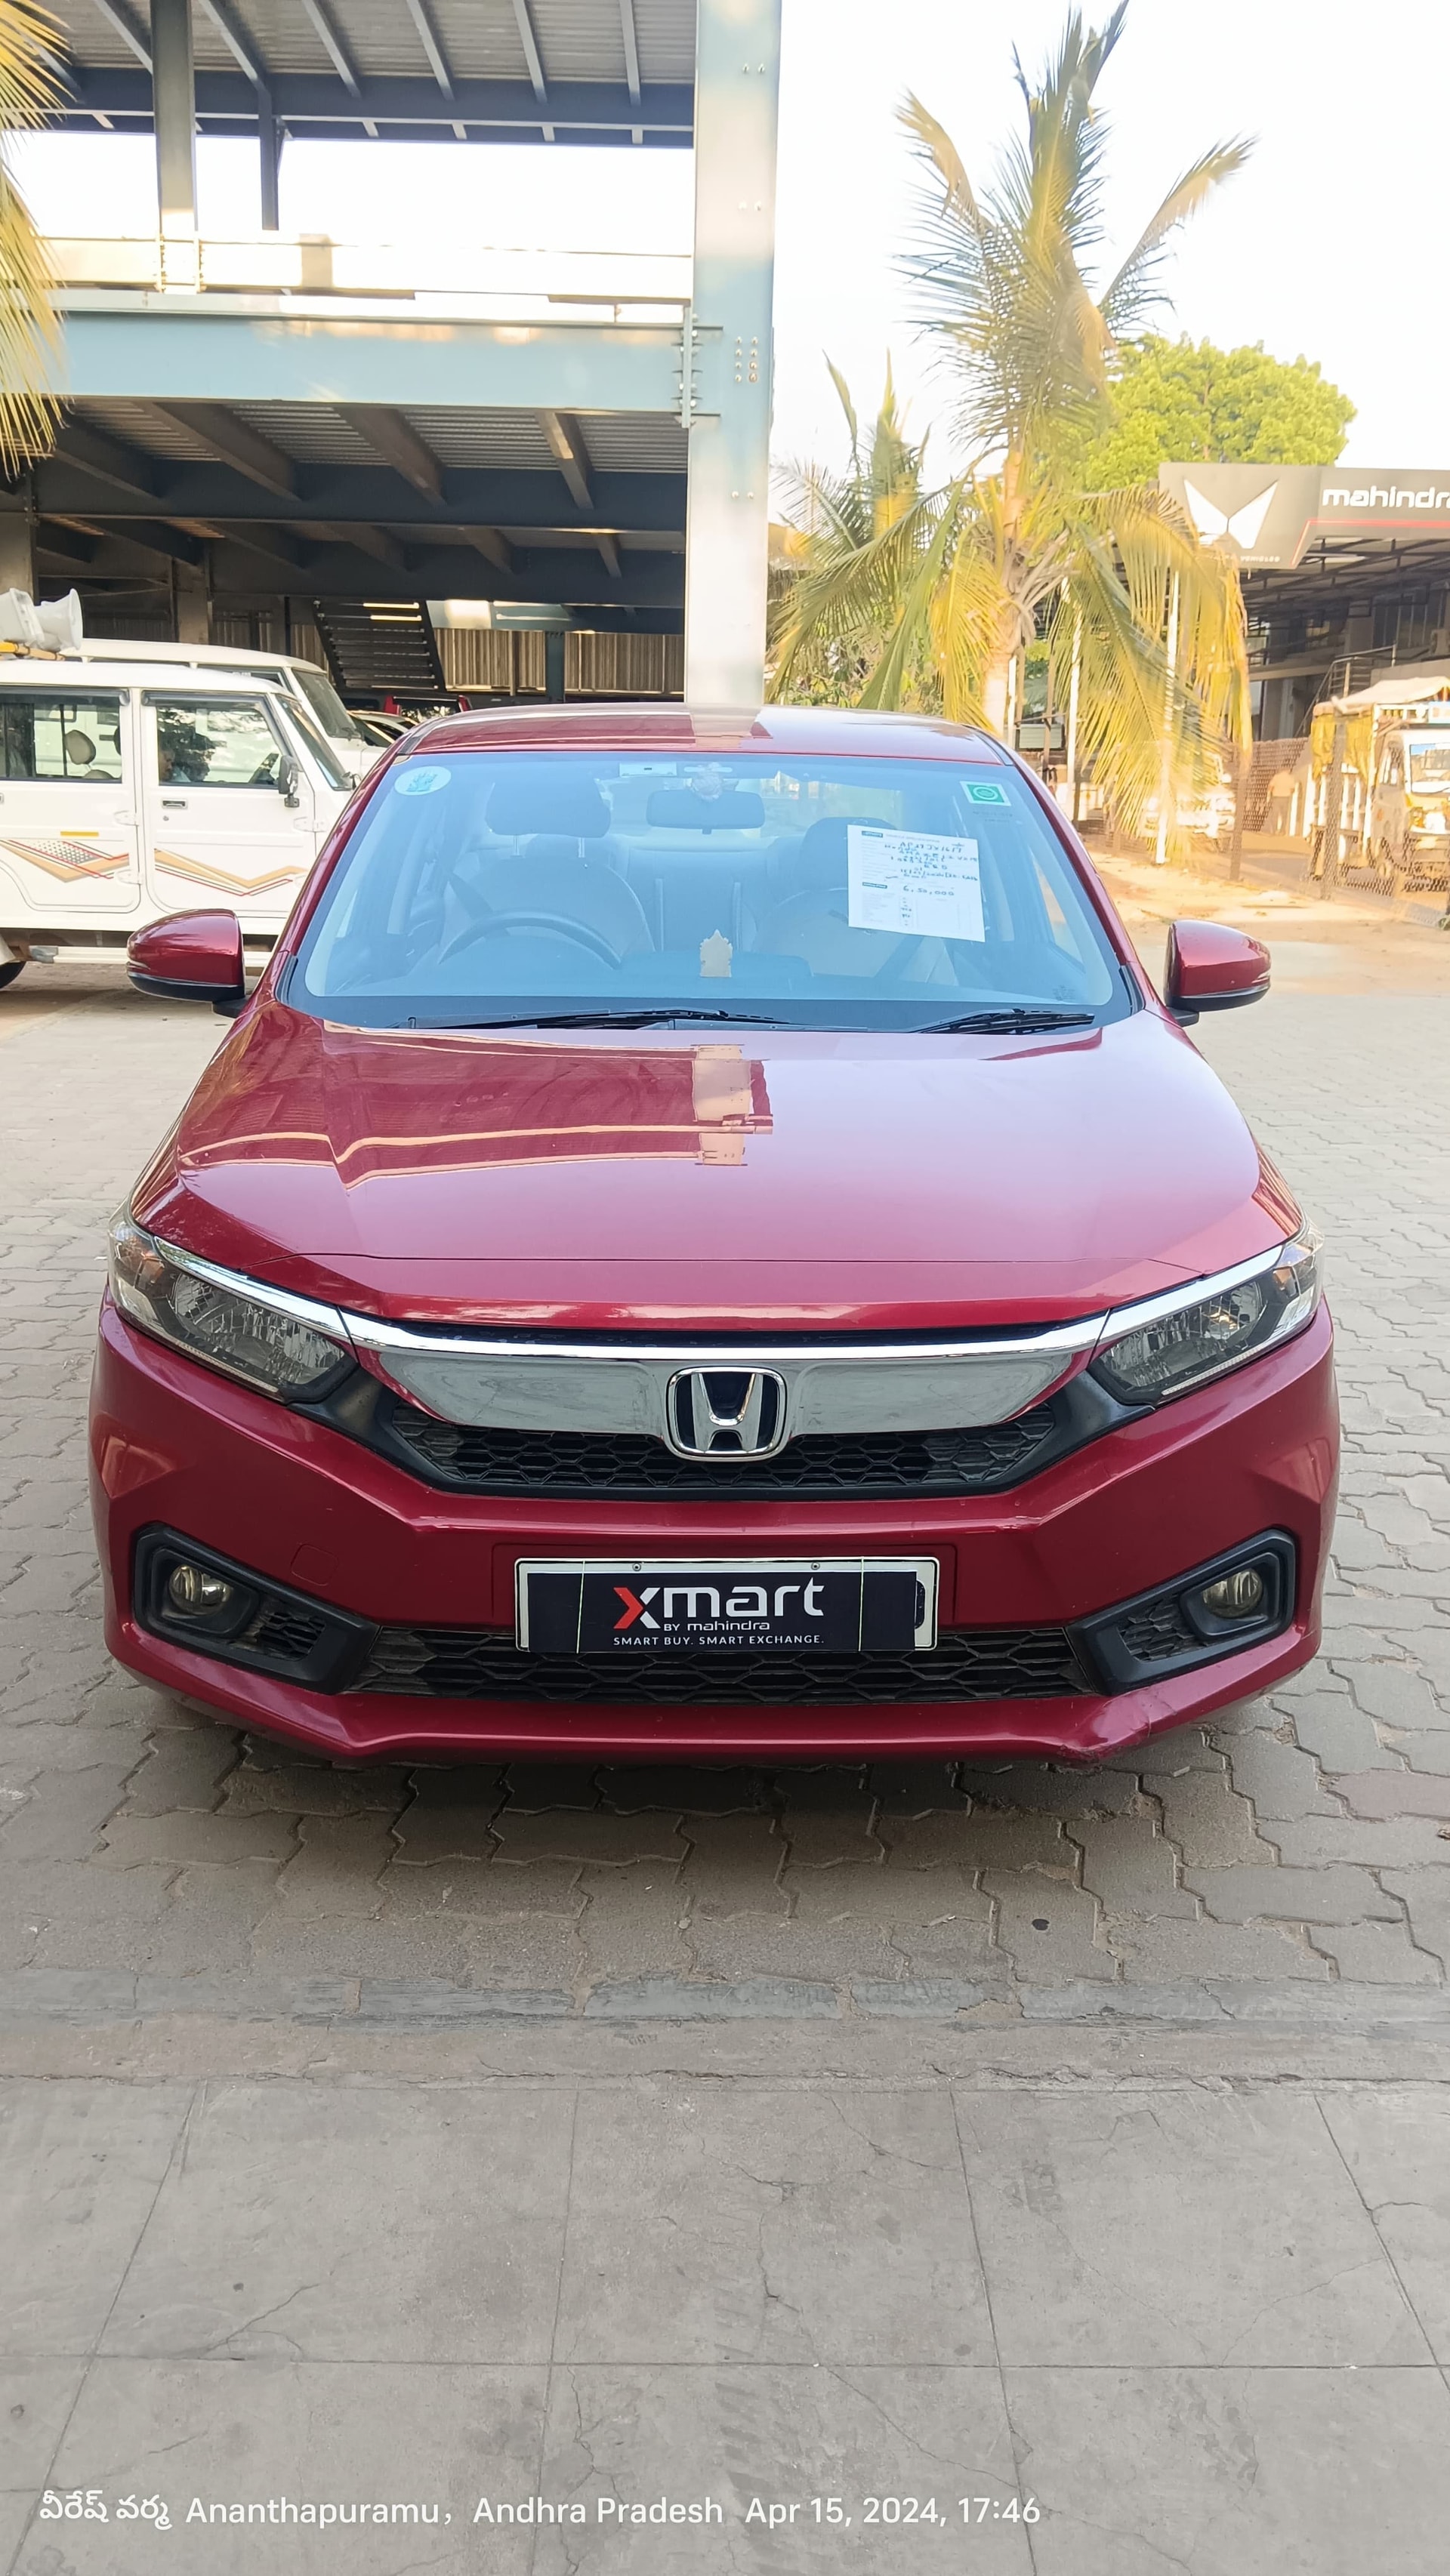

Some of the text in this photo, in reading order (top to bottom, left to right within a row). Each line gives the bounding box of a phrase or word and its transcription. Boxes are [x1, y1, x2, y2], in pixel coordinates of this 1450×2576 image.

[1322, 485, 1450, 509] mahindr
[664, 1621, 770, 1632] BY mahindra
[613, 1635, 825, 1646] SMART BUY. SMART EXCHANGE.
